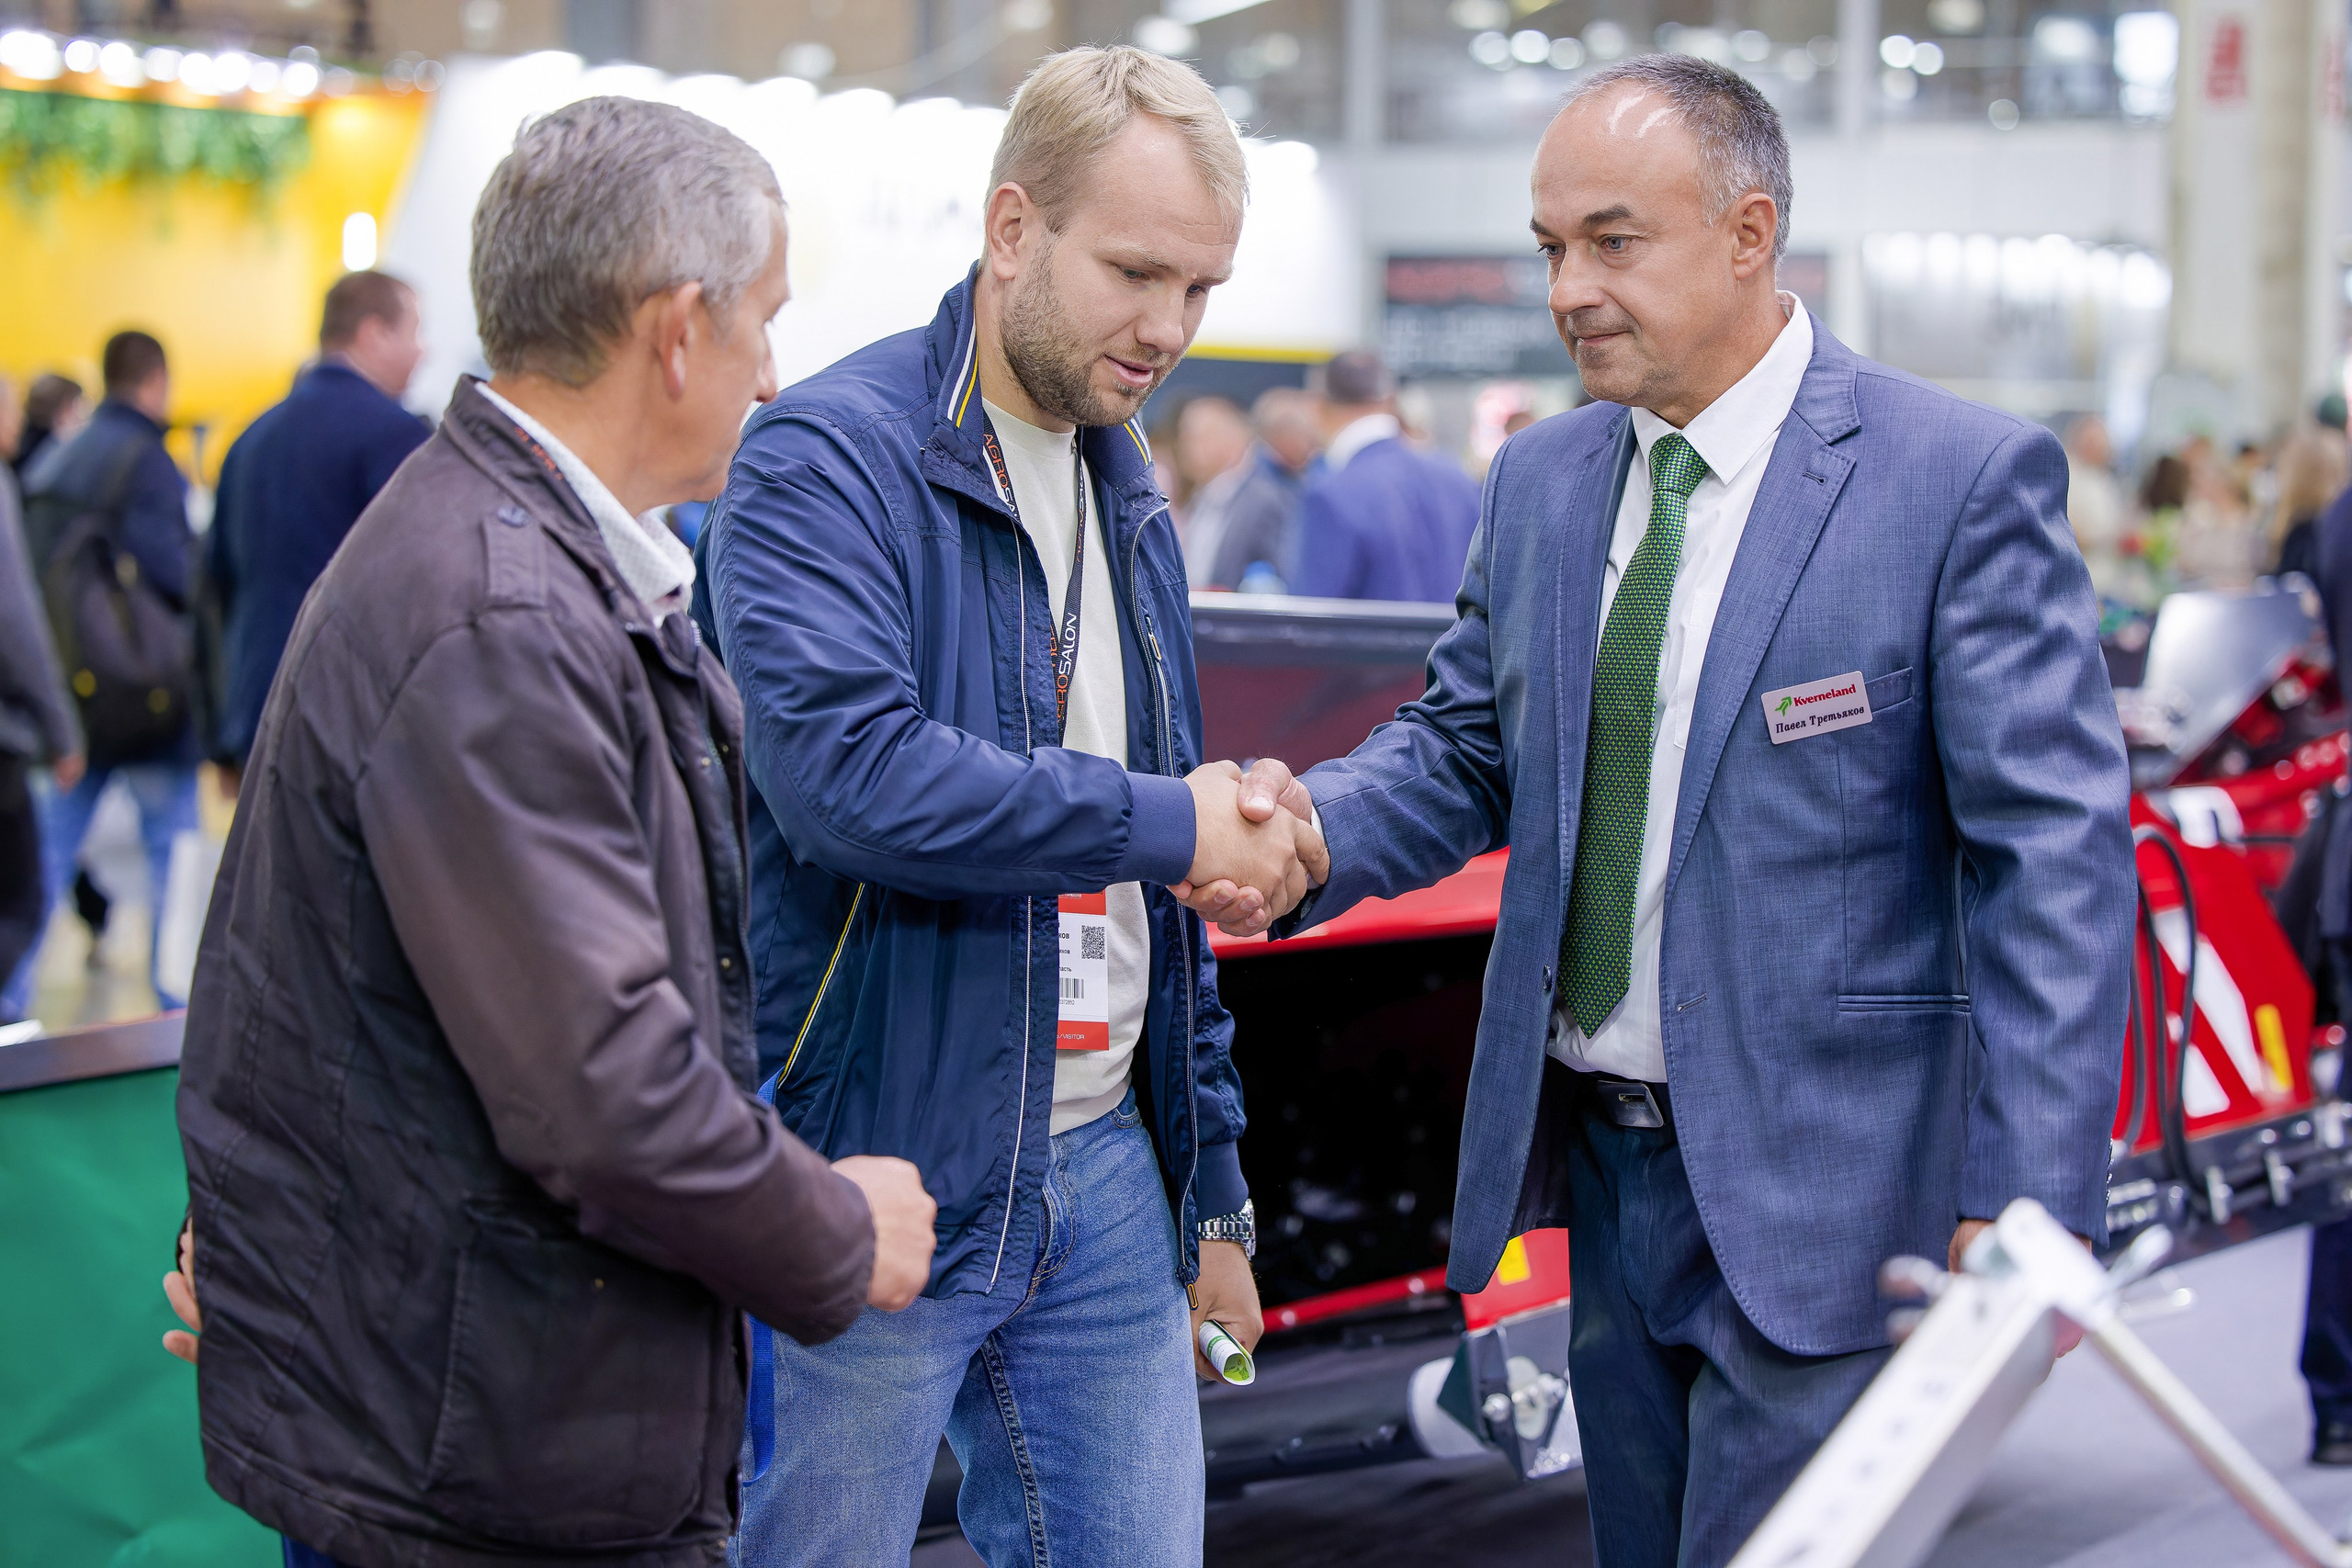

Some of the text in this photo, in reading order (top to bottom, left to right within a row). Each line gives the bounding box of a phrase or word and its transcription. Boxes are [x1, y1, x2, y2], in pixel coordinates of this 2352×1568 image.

[983, 434, 1017, 516] AGROSA
[1793, 683, 1857, 707] Kverneland
[1775, 706, 1864, 734] Павел Третьяков
